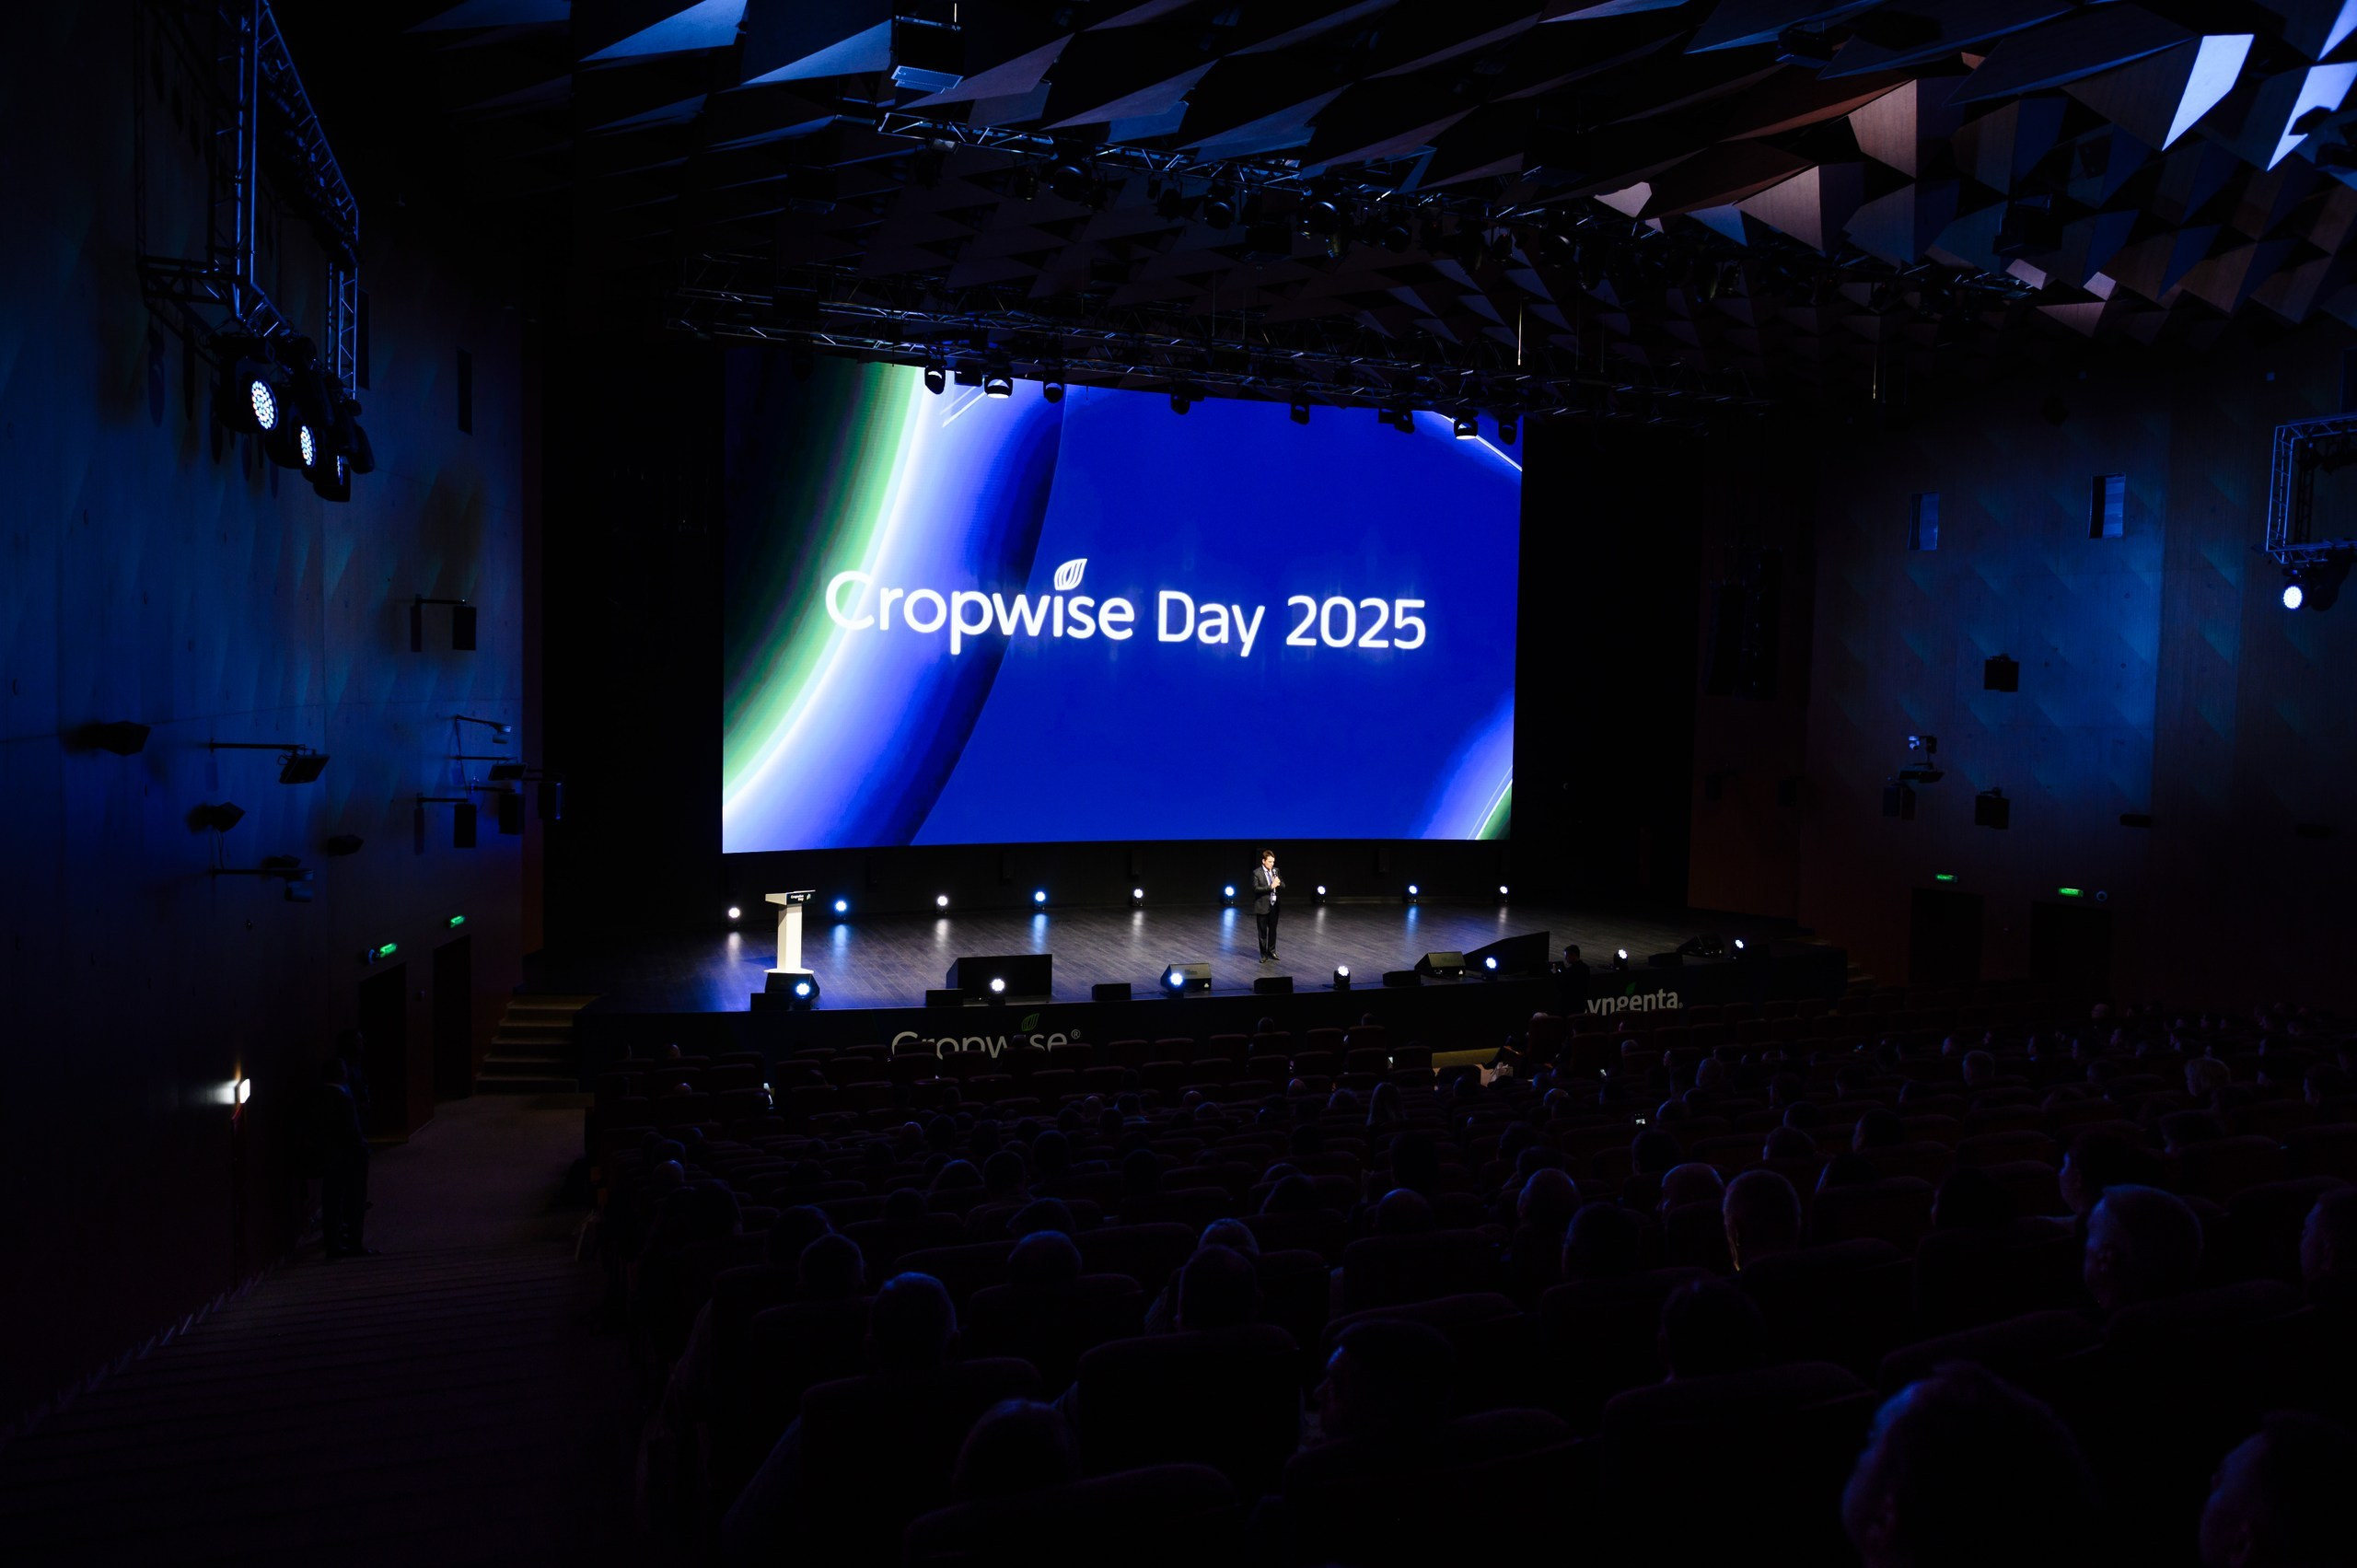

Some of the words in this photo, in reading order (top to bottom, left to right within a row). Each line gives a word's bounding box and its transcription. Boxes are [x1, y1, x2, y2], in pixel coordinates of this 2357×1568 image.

[826, 559, 1134, 655] Cropwise
[1157, 591, 1265, 656] Day
[1286, 596, 1425, 649] 2025
